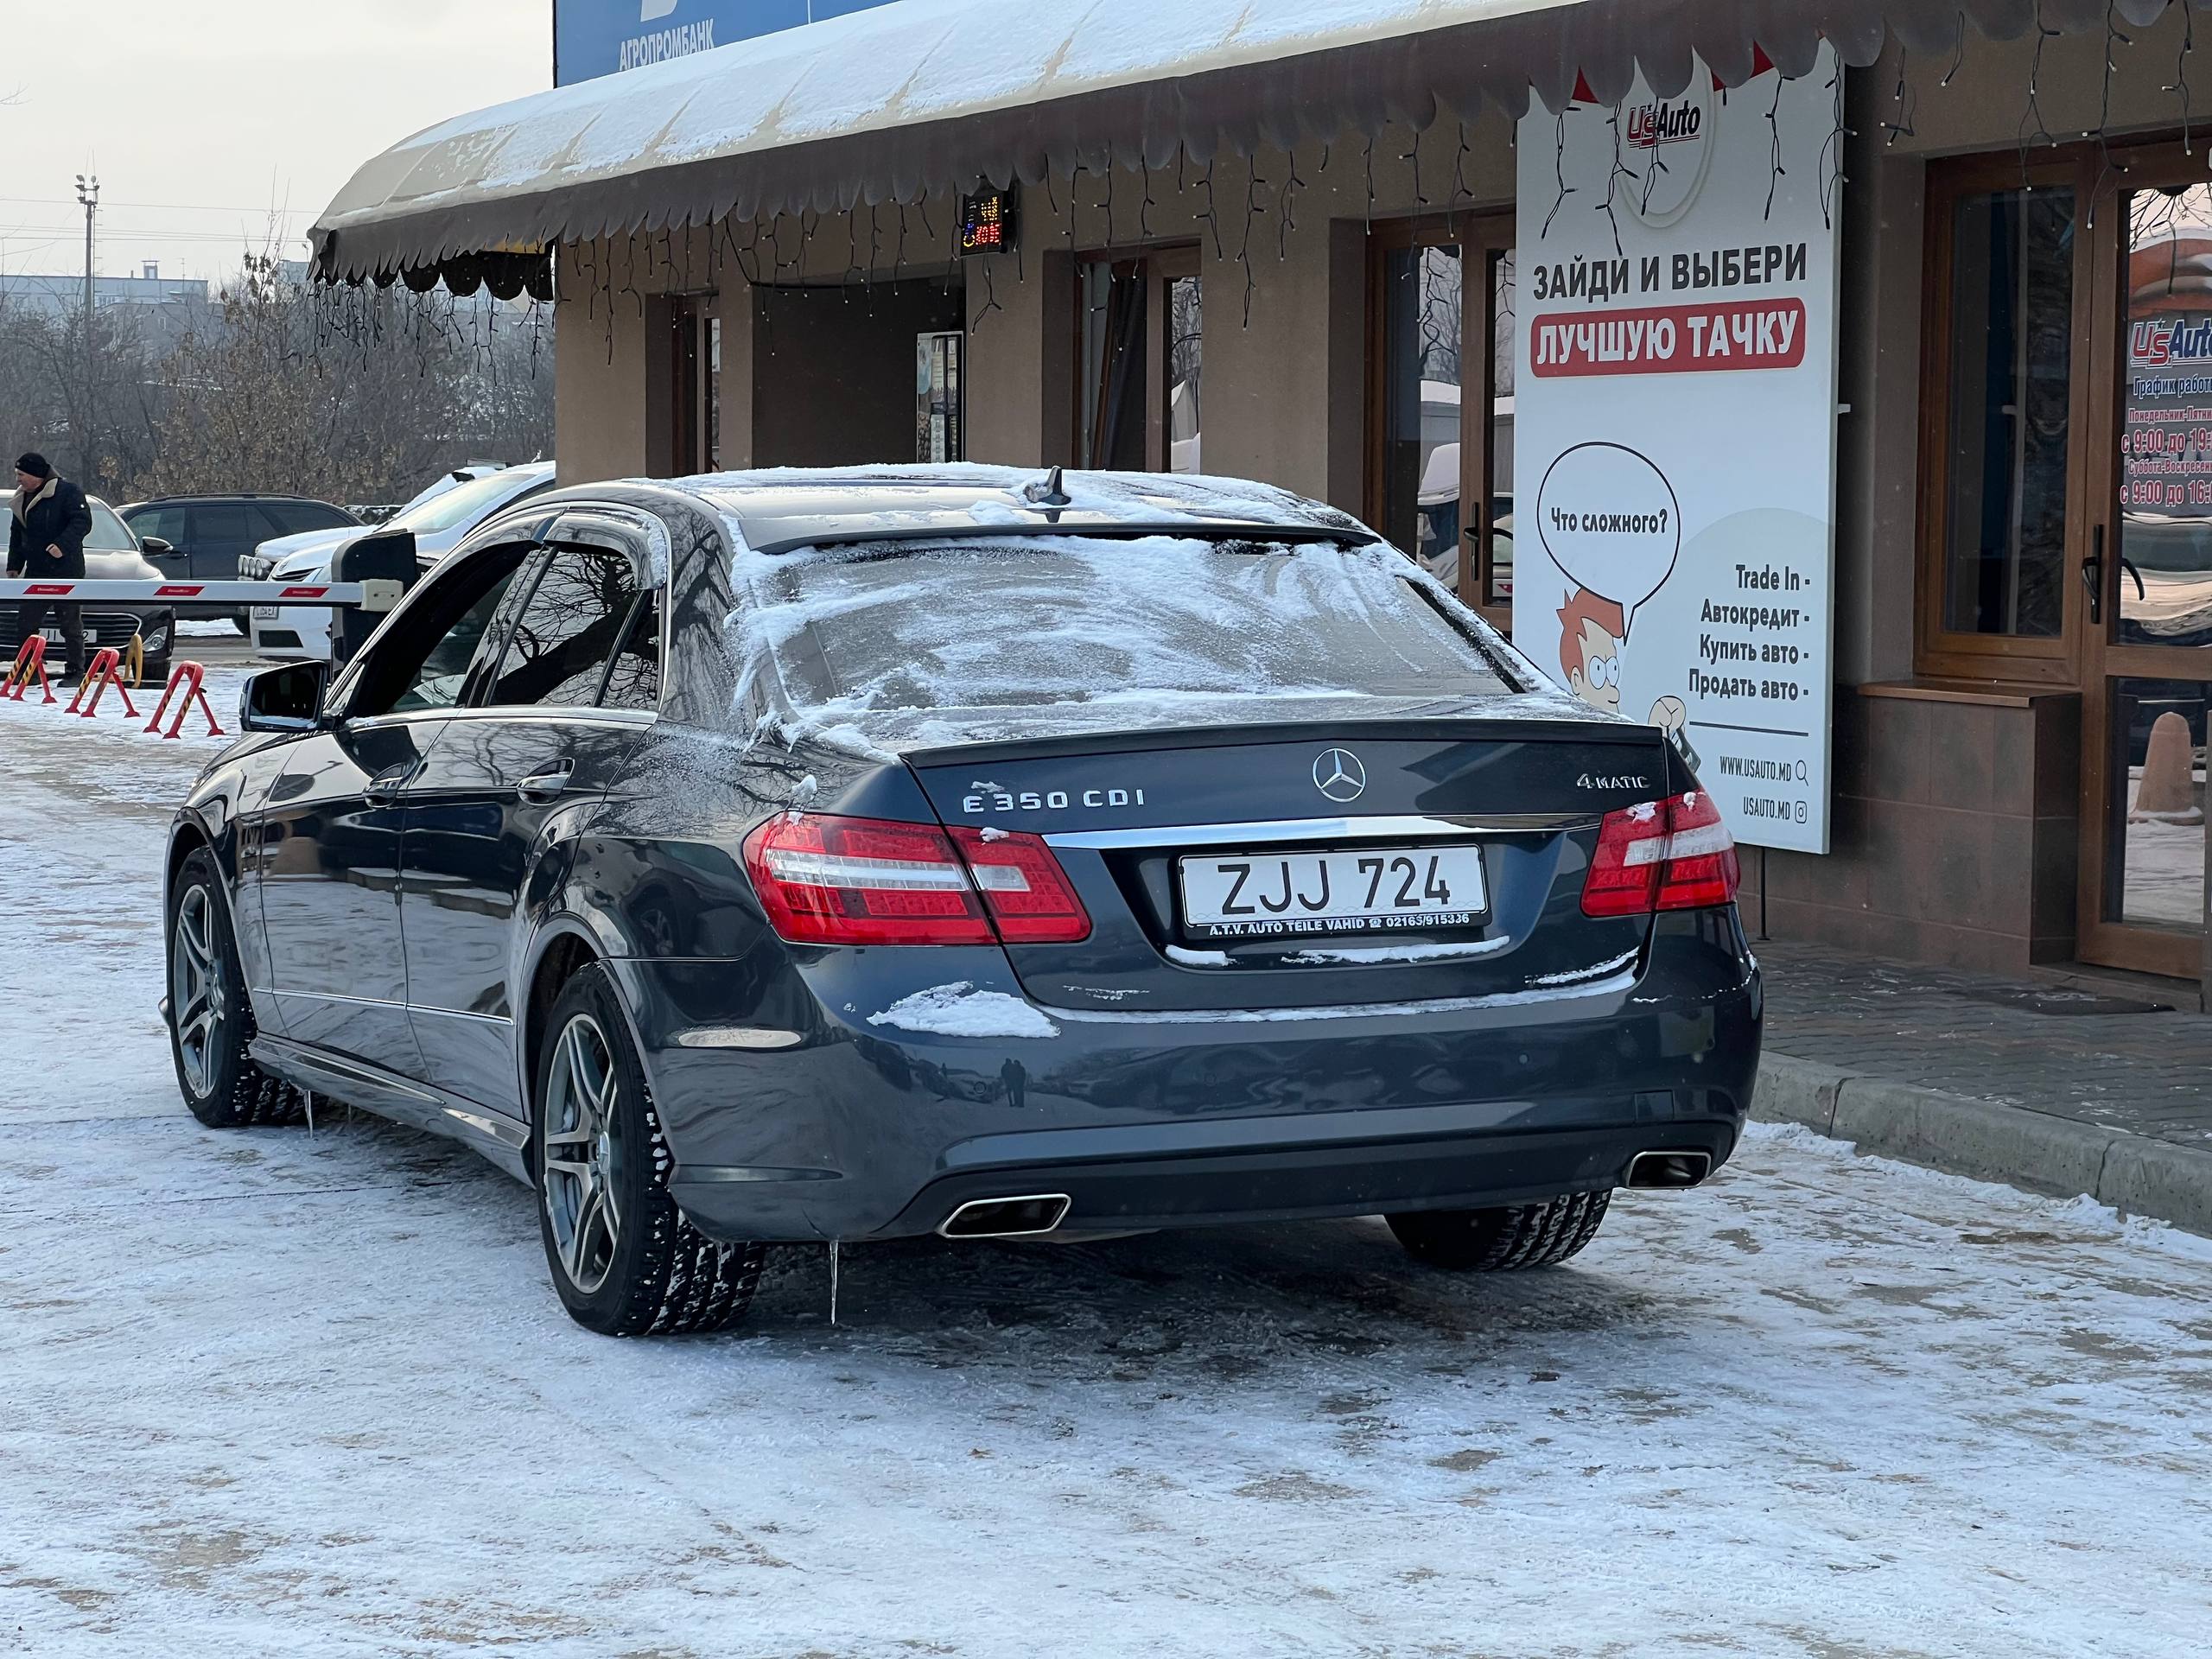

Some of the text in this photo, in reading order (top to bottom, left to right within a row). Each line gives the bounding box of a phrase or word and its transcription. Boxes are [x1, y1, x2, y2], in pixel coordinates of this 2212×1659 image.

[619, 17, 715, 72] АГРОПРОМБАНК
[1533, 243, 1807, 303] ЗАЙДИ И ВЫБЕРИ
[1536, 309, 1798, 365] ЛУЧШУЮ ТАЧКУ
[2133, 375, 2176, 399] График
[2133, 429, 2164, 453] 9:00
[2167, 433, 2186, 454] до
[2190, 427, 2212, 452] 19:
[2132, 480, 2163, 504] 9:00
[2165, 485, 2184, 507] до
[2188, 480, 2212, 504] 16:
[1551, 507, 1668, 533] Что сложного?
[1735, 564, 1800, 591] Trade In
[1700, 599, 1800, 631] Автокредит
[1700, 633, 1799, 665] Купить авто
[1688, 669, 1798, 701] Продать авто
[1719, 756, 1791, 782] WWW.USAUTO.MD
[1083, 789, 1144, 807] CDI
[1744, 797, 1790, 820] USAUTO.MD
[1217, 855, 1451, 915] ZJJ 724
[1210, 924, 1244, 936] A.T.V.
[1248, 921, 1283, 935] AUTO
[1286, 919, 1323, 932] TEILE
[1325, 918, 1365, 931] VAHID
